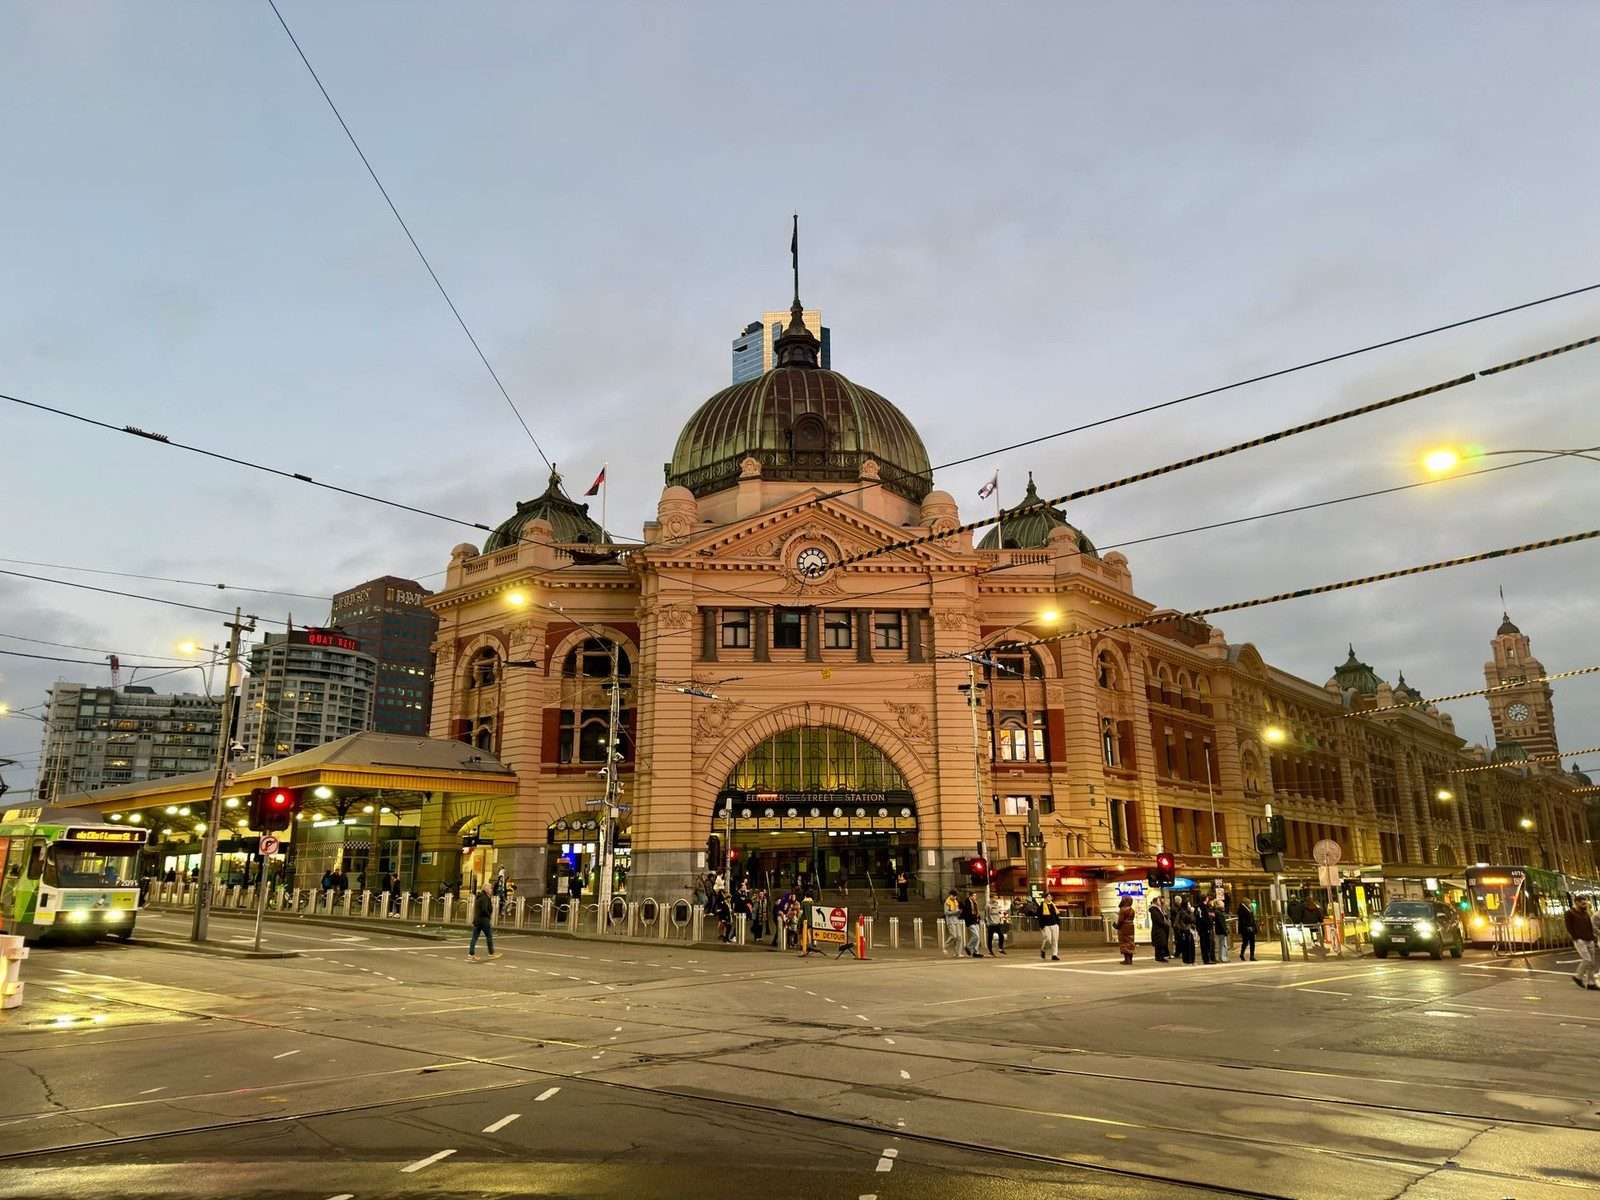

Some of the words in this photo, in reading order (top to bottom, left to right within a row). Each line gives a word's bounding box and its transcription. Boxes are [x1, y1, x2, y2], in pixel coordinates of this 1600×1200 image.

[746, 793, 791, 802] FLINDERS
[800, 794, 834, 802] STREET
[845, 793, 885, 802] STATION
[823, 931, 846, 941] DETOUR
